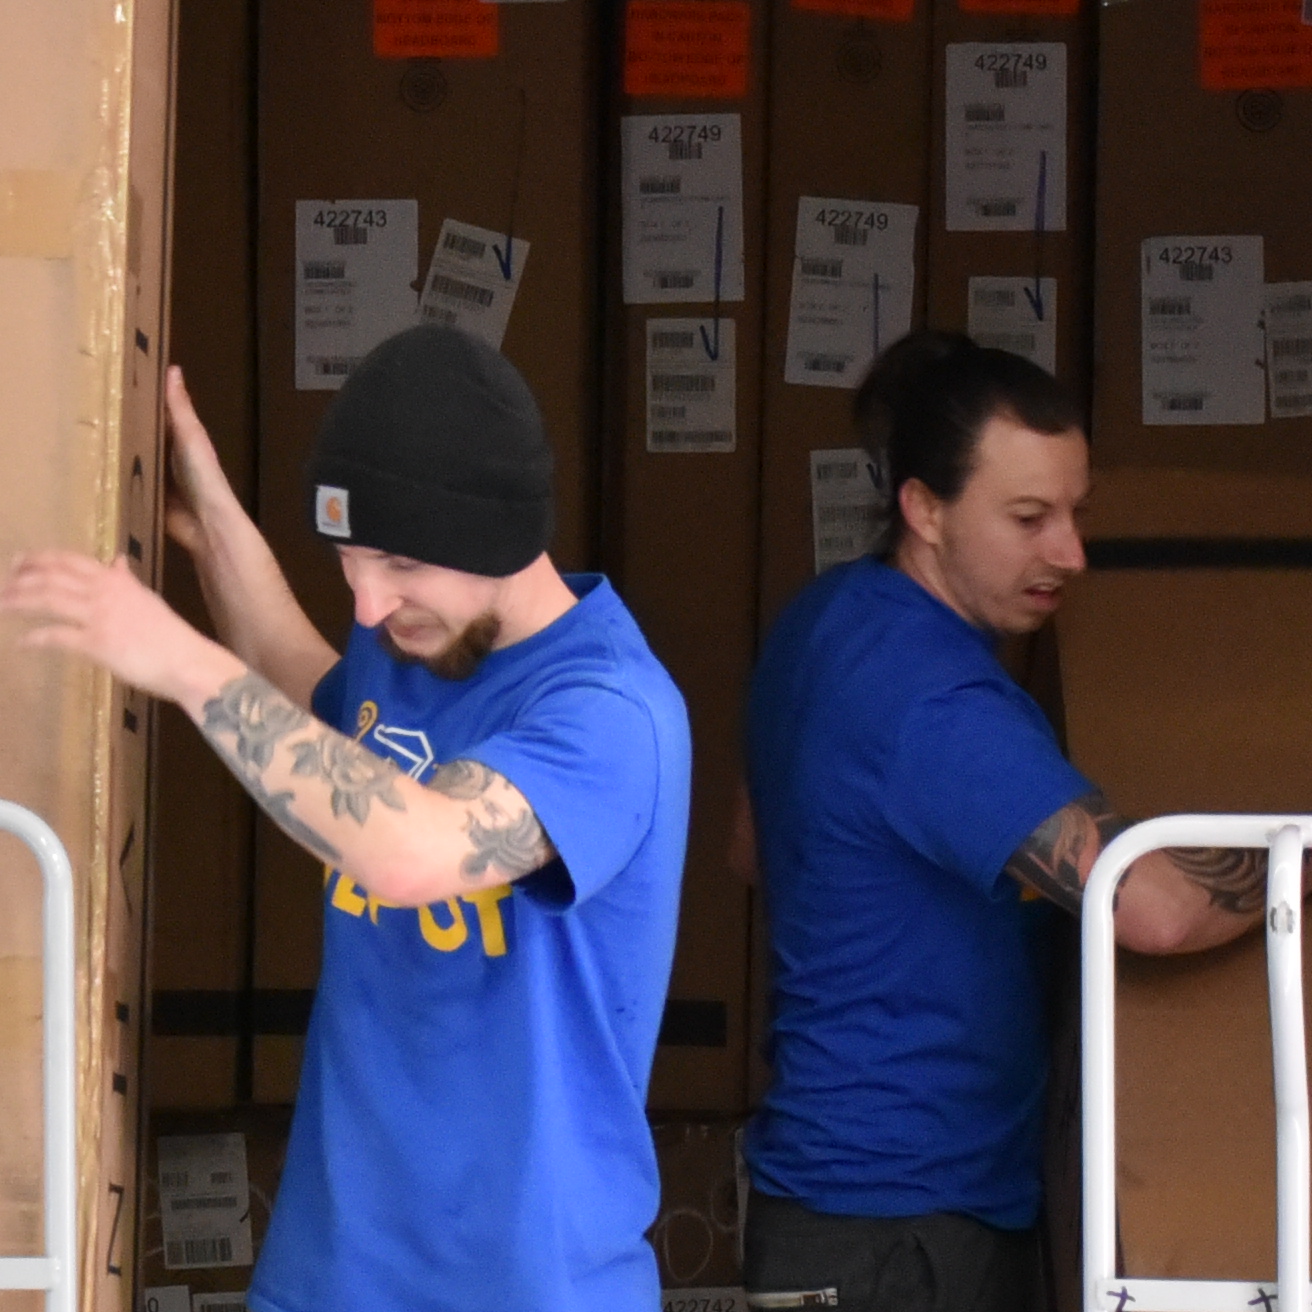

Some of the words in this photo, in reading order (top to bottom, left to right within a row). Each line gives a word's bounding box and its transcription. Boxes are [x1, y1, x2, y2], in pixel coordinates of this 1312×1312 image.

[974, 53, 1047, 71] 422749
[648, 125, 722, 143] 422749
[313, 209, 388, 228] 422743
[815, 208, 889, 231] 422749
[1159, 245, 1233, 264] 422743
